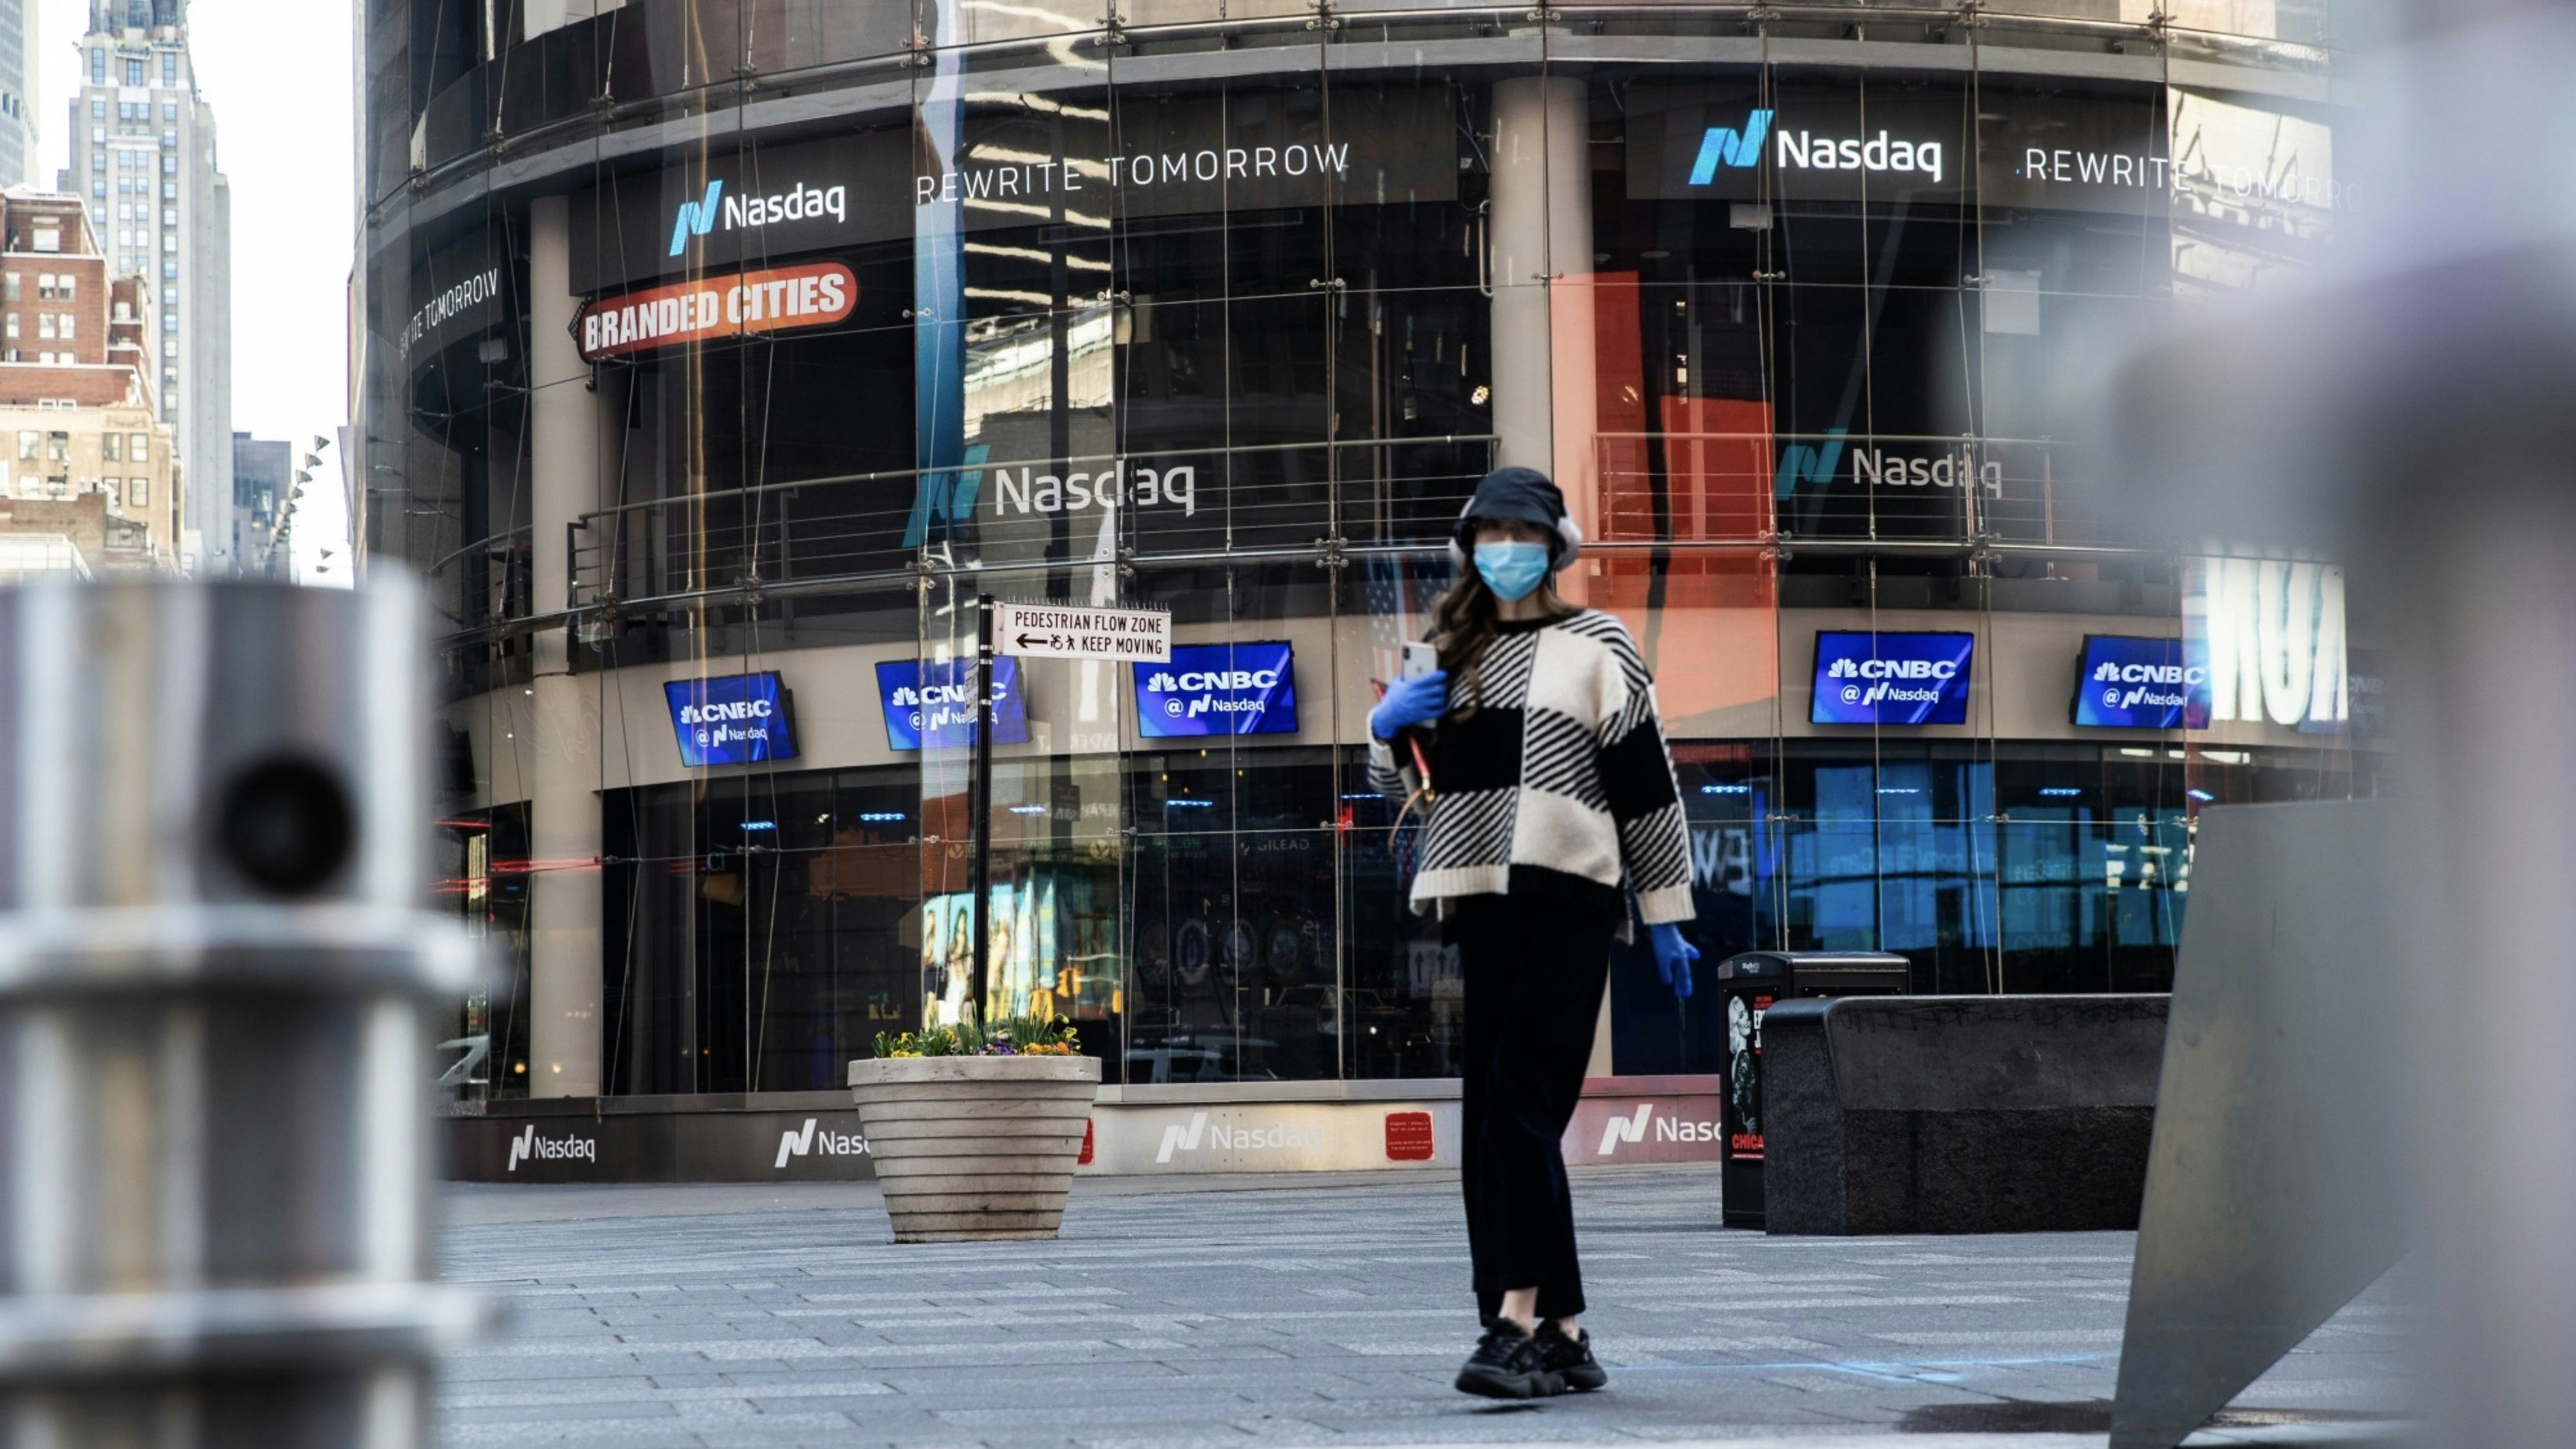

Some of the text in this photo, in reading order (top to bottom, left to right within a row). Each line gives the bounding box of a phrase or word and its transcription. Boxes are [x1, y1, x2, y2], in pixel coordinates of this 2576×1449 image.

[1777, 129, 1942, 183] Nasdaq
[916, 142, 1349, 206] REWRITE TOMORROW
[2026, 148, 2363, 212] REWRITE TOMORRO
[725, 182, 846, 230] Nasdaq
[424, 268, 497, 330] TOMORROW
[585, 273, 846, 353] BRANDED CITIES
[995, 460, 1195, 517] Nasdaq
[1015, 611, 1162, 634] PEDESTRIAN FLOW ZONE
[1081, 636, 1162, 655] KEEP MOVING
[1178, 670, 1278, 691] CNBC
[1860, 659, 1957, 679] CNBC
[2121, 664, 2206, 685] CNBC
[921, 682, 1007, 704] CNC
[1841, 684, 1939, 705] @ Nasdaq
[2103, 688, 2188, 708] @ Nasdaq
[701, 699, 772, 722] CNBC
[951, 712, 999, 725] Naq
[1164, 698, 1266, 718] @ Nasdaq
[695, 727, 768, 747] @ Nasdaq
[535, 1133, 596, 1164] Nasdaq
[818, 1130, 870, 1155] Nas
[1211, 1123, 1322, 1153] Nasdaq
